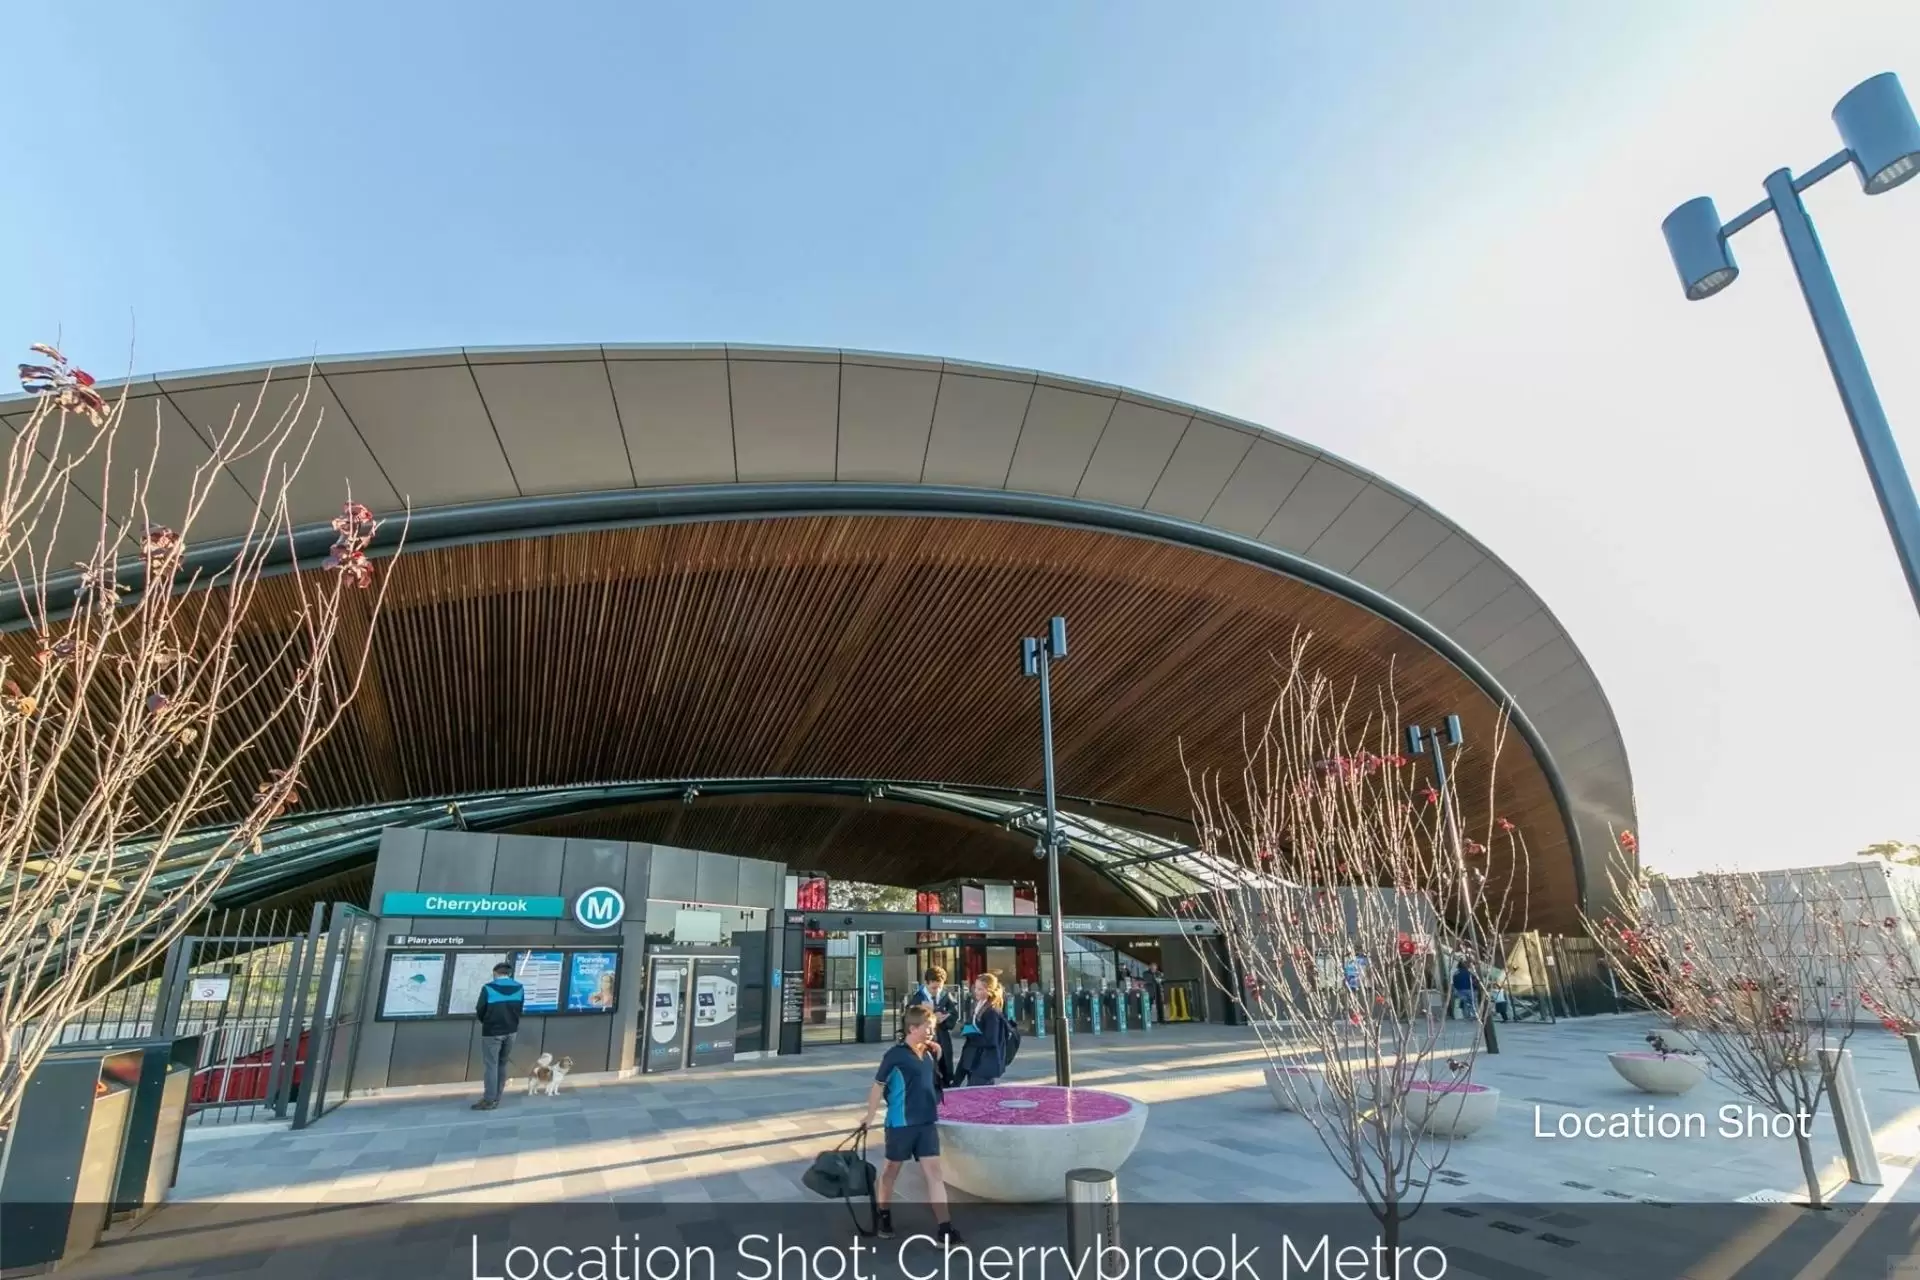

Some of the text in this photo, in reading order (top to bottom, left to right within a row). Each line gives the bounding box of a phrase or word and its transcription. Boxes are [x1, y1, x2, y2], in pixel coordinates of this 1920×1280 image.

[425, 896, 527, 913] Cherrybrook
[587, 896, 613, 920] M
[1061, 921, 1092, 930] latforms
[407, 936, 465, 945] Plan your trip
